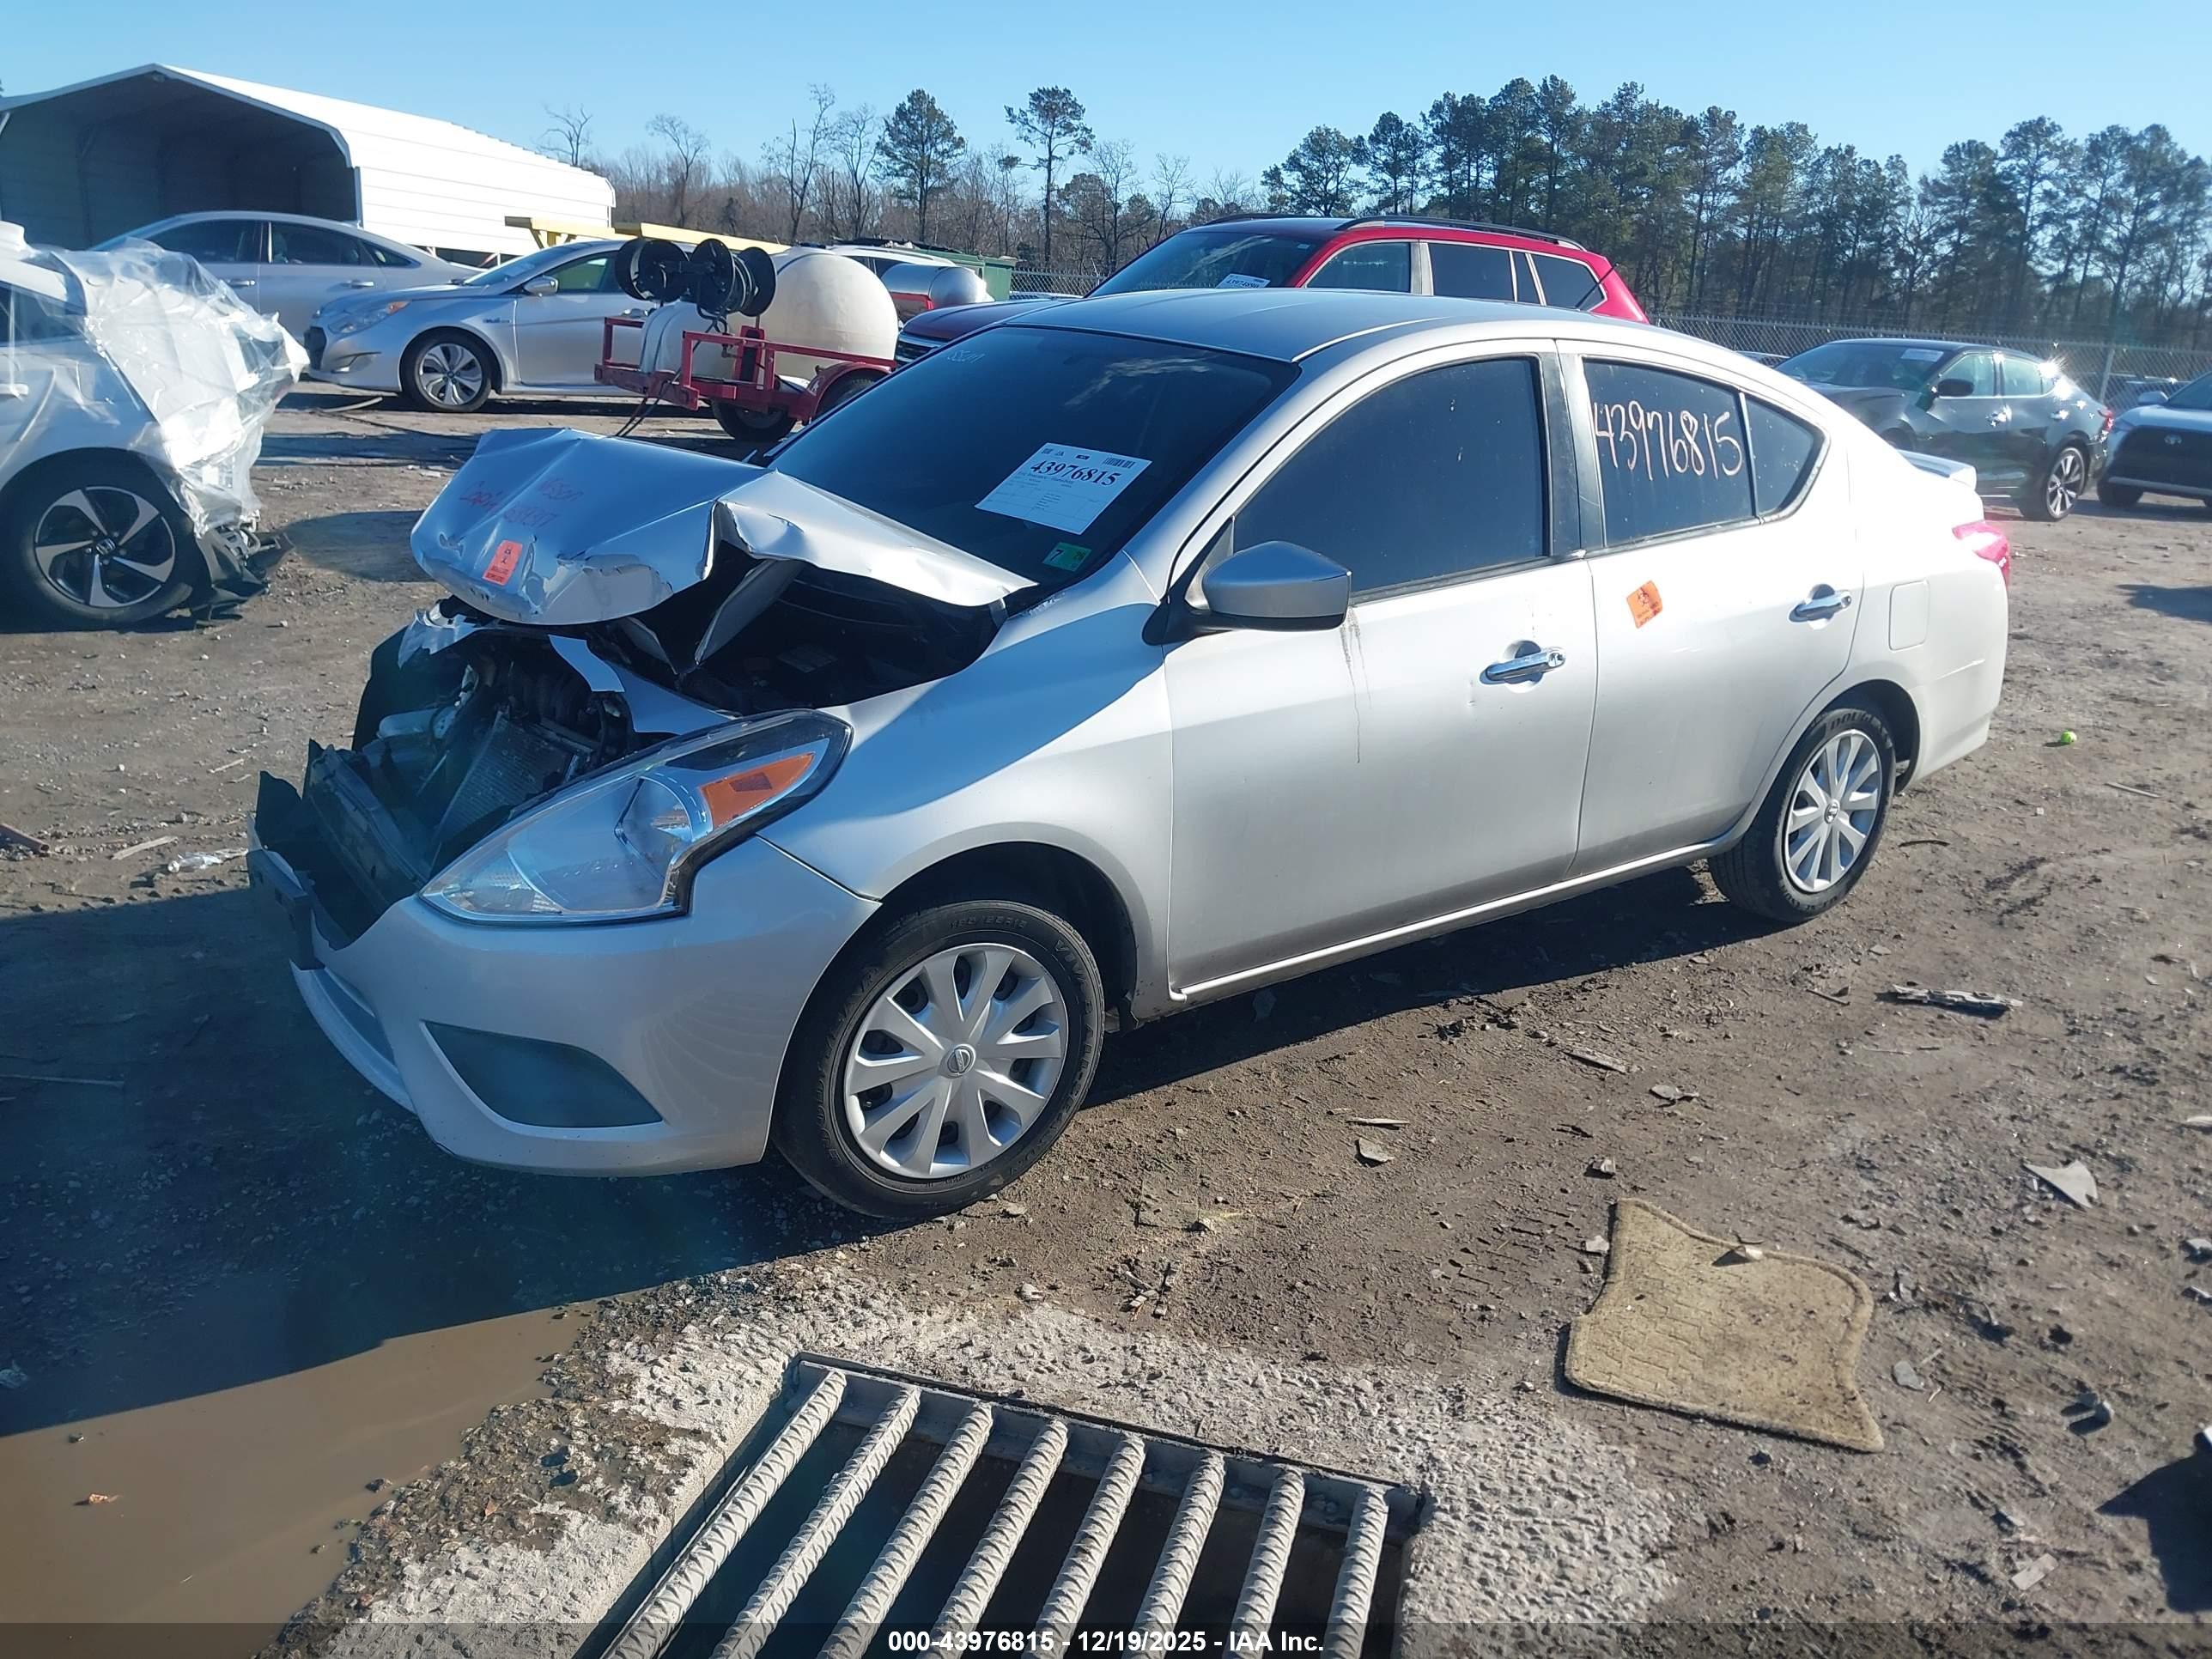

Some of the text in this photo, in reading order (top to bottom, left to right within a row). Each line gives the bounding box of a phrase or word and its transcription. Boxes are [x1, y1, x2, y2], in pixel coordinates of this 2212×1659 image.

[1593, 401, 1745, 481] 43976815
[1030, 460, 1121, 486] 43976815
[1050, 549, 1064, 562] 7
